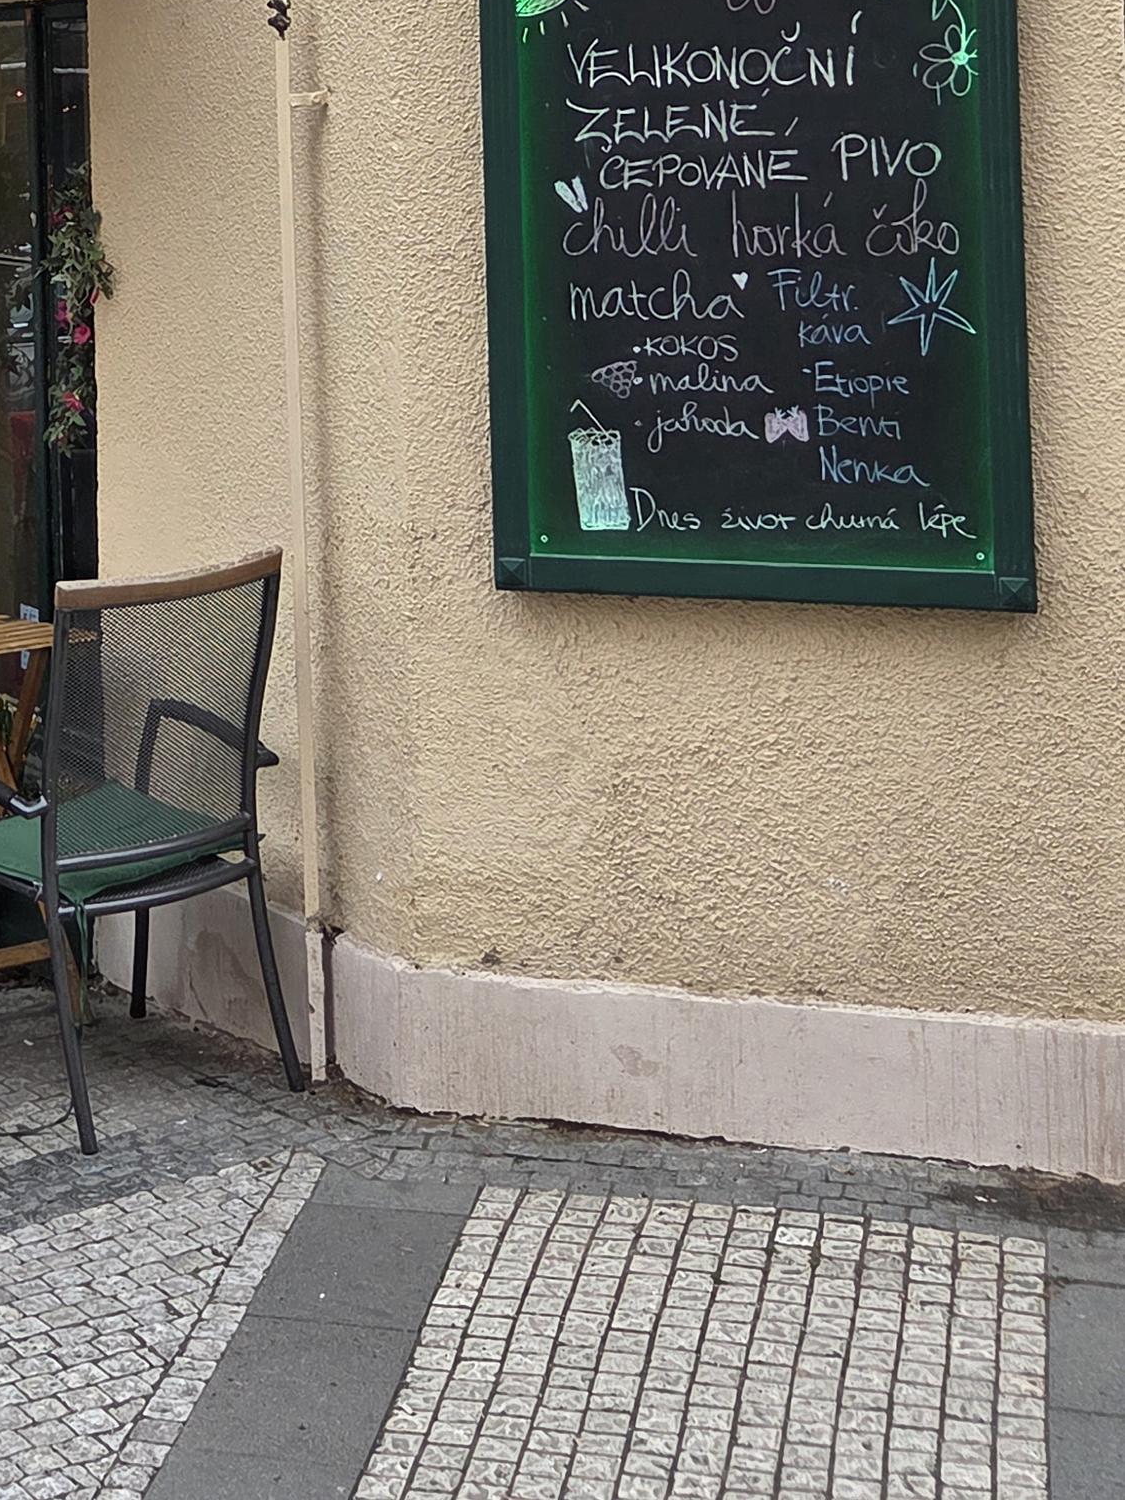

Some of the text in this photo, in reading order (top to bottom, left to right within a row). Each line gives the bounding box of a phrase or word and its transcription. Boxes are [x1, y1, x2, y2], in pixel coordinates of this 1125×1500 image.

[567, 10, 863, 90] VELIKONOČNÍ
[565, 88, 776, 145] ZELENÉ
[598, 116, 944, 191] ČEPOVANÉ PIVO
[561, 192, 698, 258] chilli
[731, 189, 848, 259] horká
[569, 268, 745, 322] matcha
[649, 362, 776, 395] malina
[646, 400, 761, 454] jahoda
[818, 444, 932, 488] Nenka
[628, 487, 703, 533] Dnes
[804, 501, 901, 532] chutná
[918, 500, 978, 540] lépe
